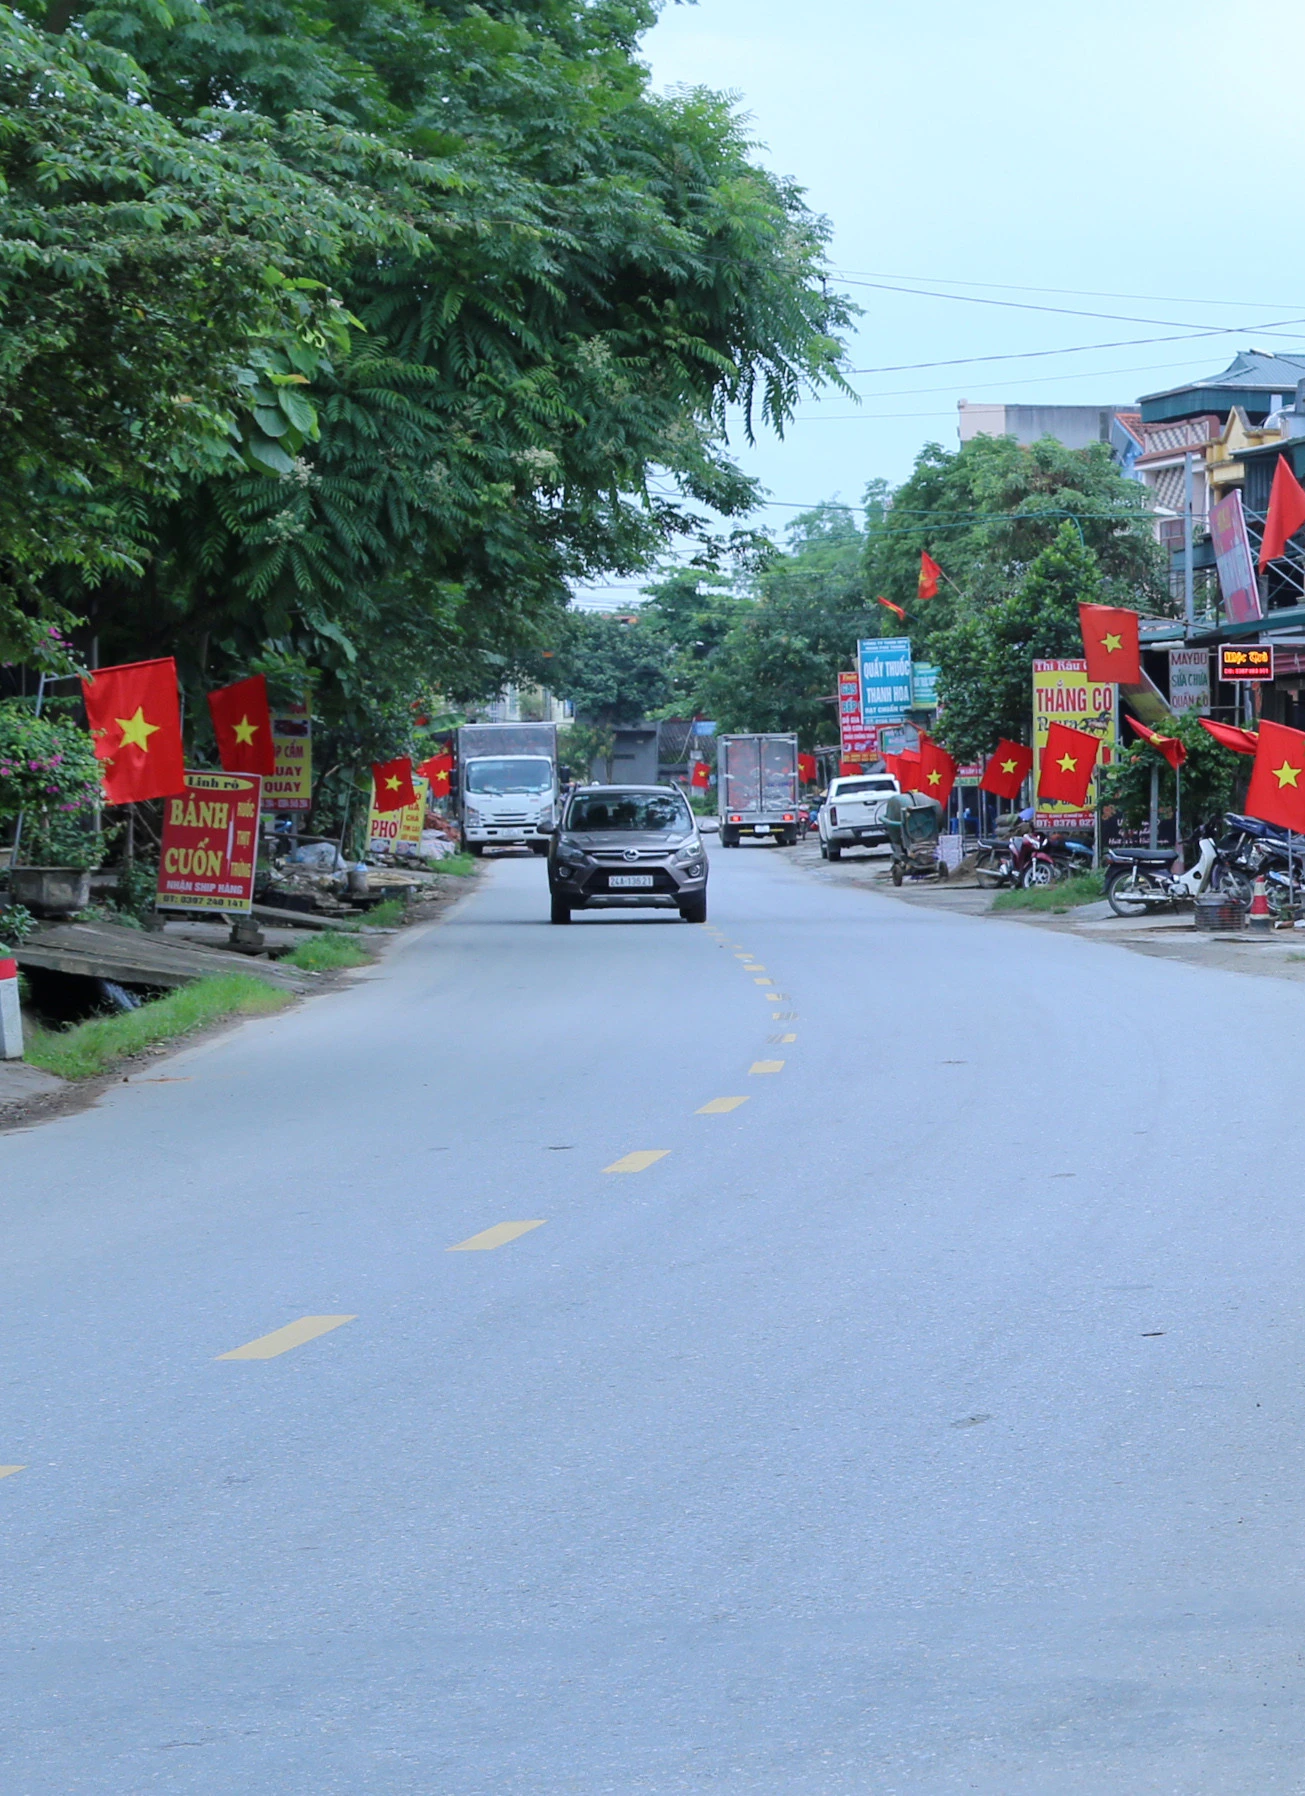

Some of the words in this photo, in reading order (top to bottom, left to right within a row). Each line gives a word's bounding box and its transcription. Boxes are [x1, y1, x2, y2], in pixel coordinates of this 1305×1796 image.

[274, 766, 302, 777] UAY
[188, 776, 219, 788] Linh
[264, 781, 302, 793] QUAY
[169, 793, 229, 829] BÁNH
[165, 838, 223, 877] CUỐN
[167, 880, 192, 892] NHẬN
[194, 882, 216, 892] SHIP
[218, 883, 243, 895] HÀNG
